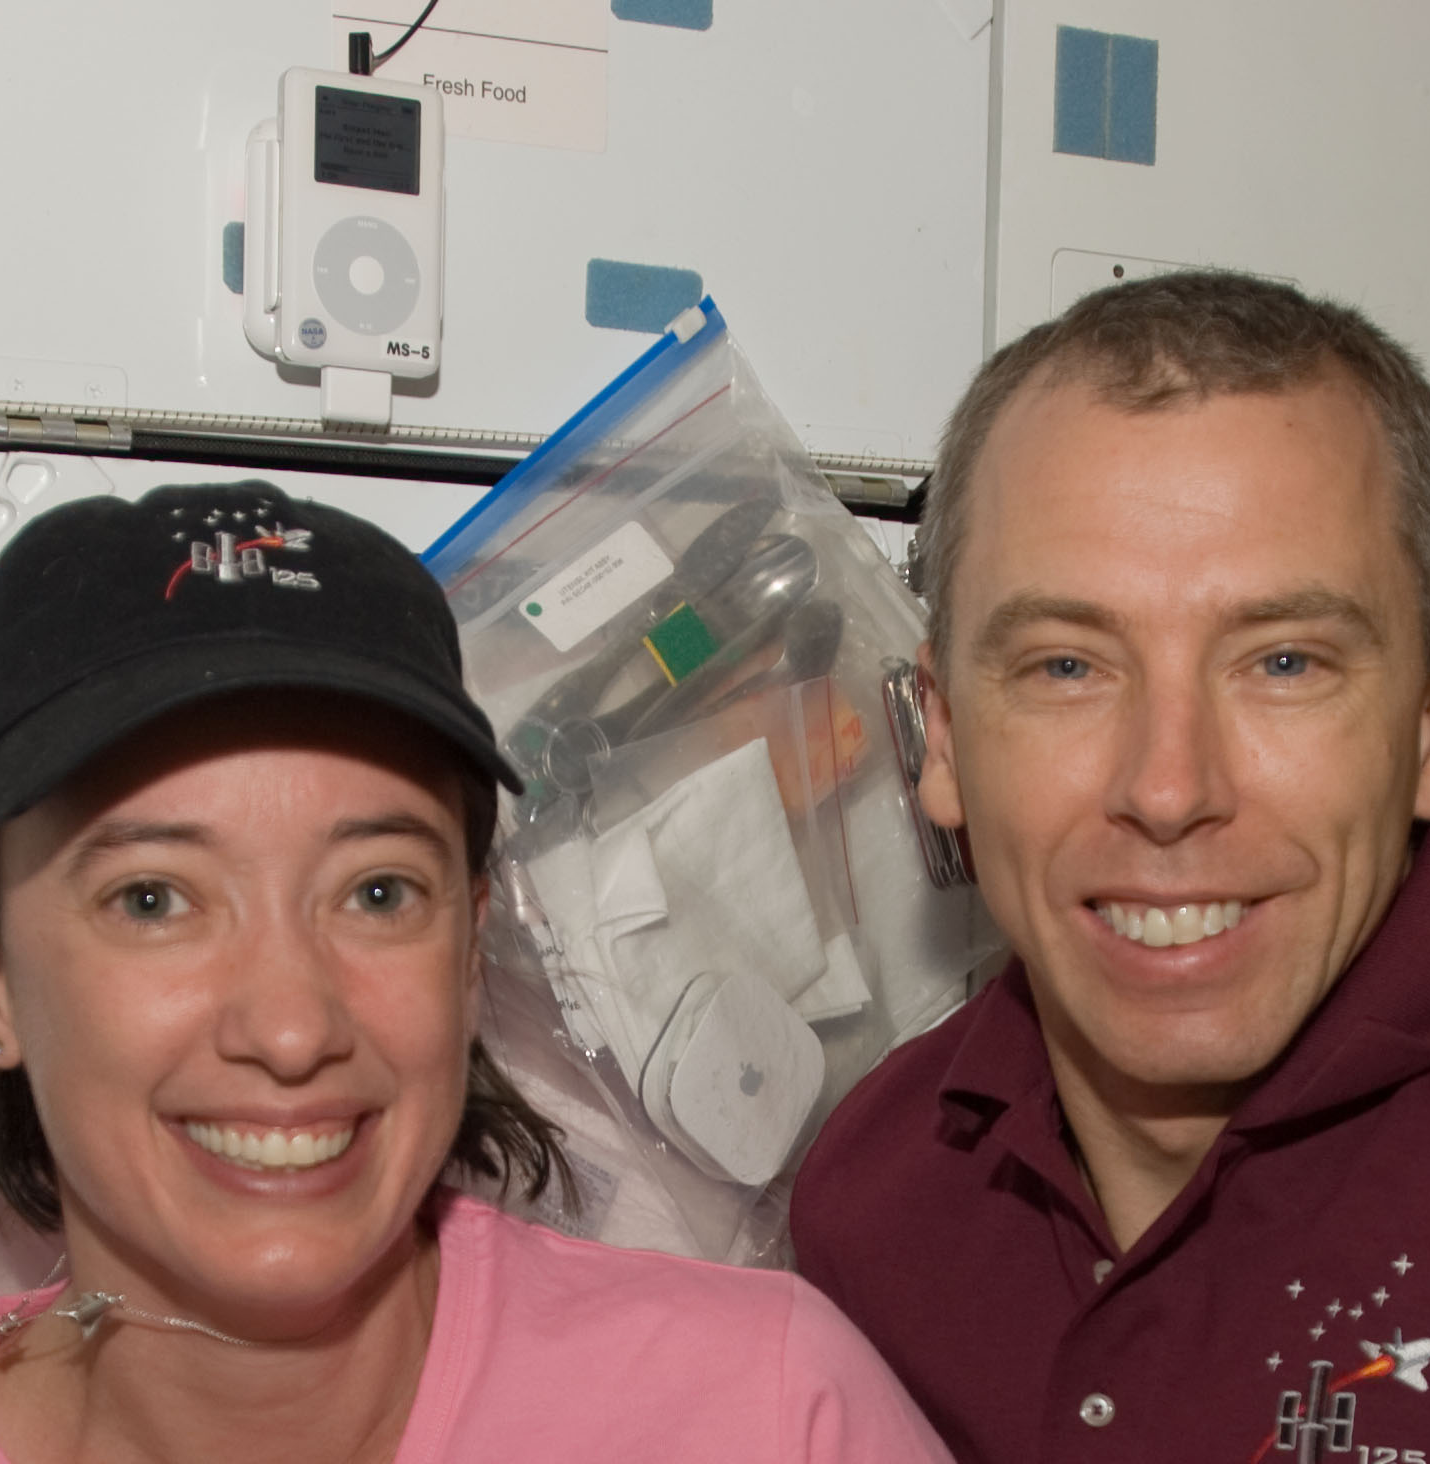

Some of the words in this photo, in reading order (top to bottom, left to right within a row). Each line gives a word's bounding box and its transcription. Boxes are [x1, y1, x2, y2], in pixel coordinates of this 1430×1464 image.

[422, 73, 475, 99] Fresh
[481, 79, 527, 105] Food
[386, 340, 431, 361] MS-5
[268, 566, 323, 591] 125
